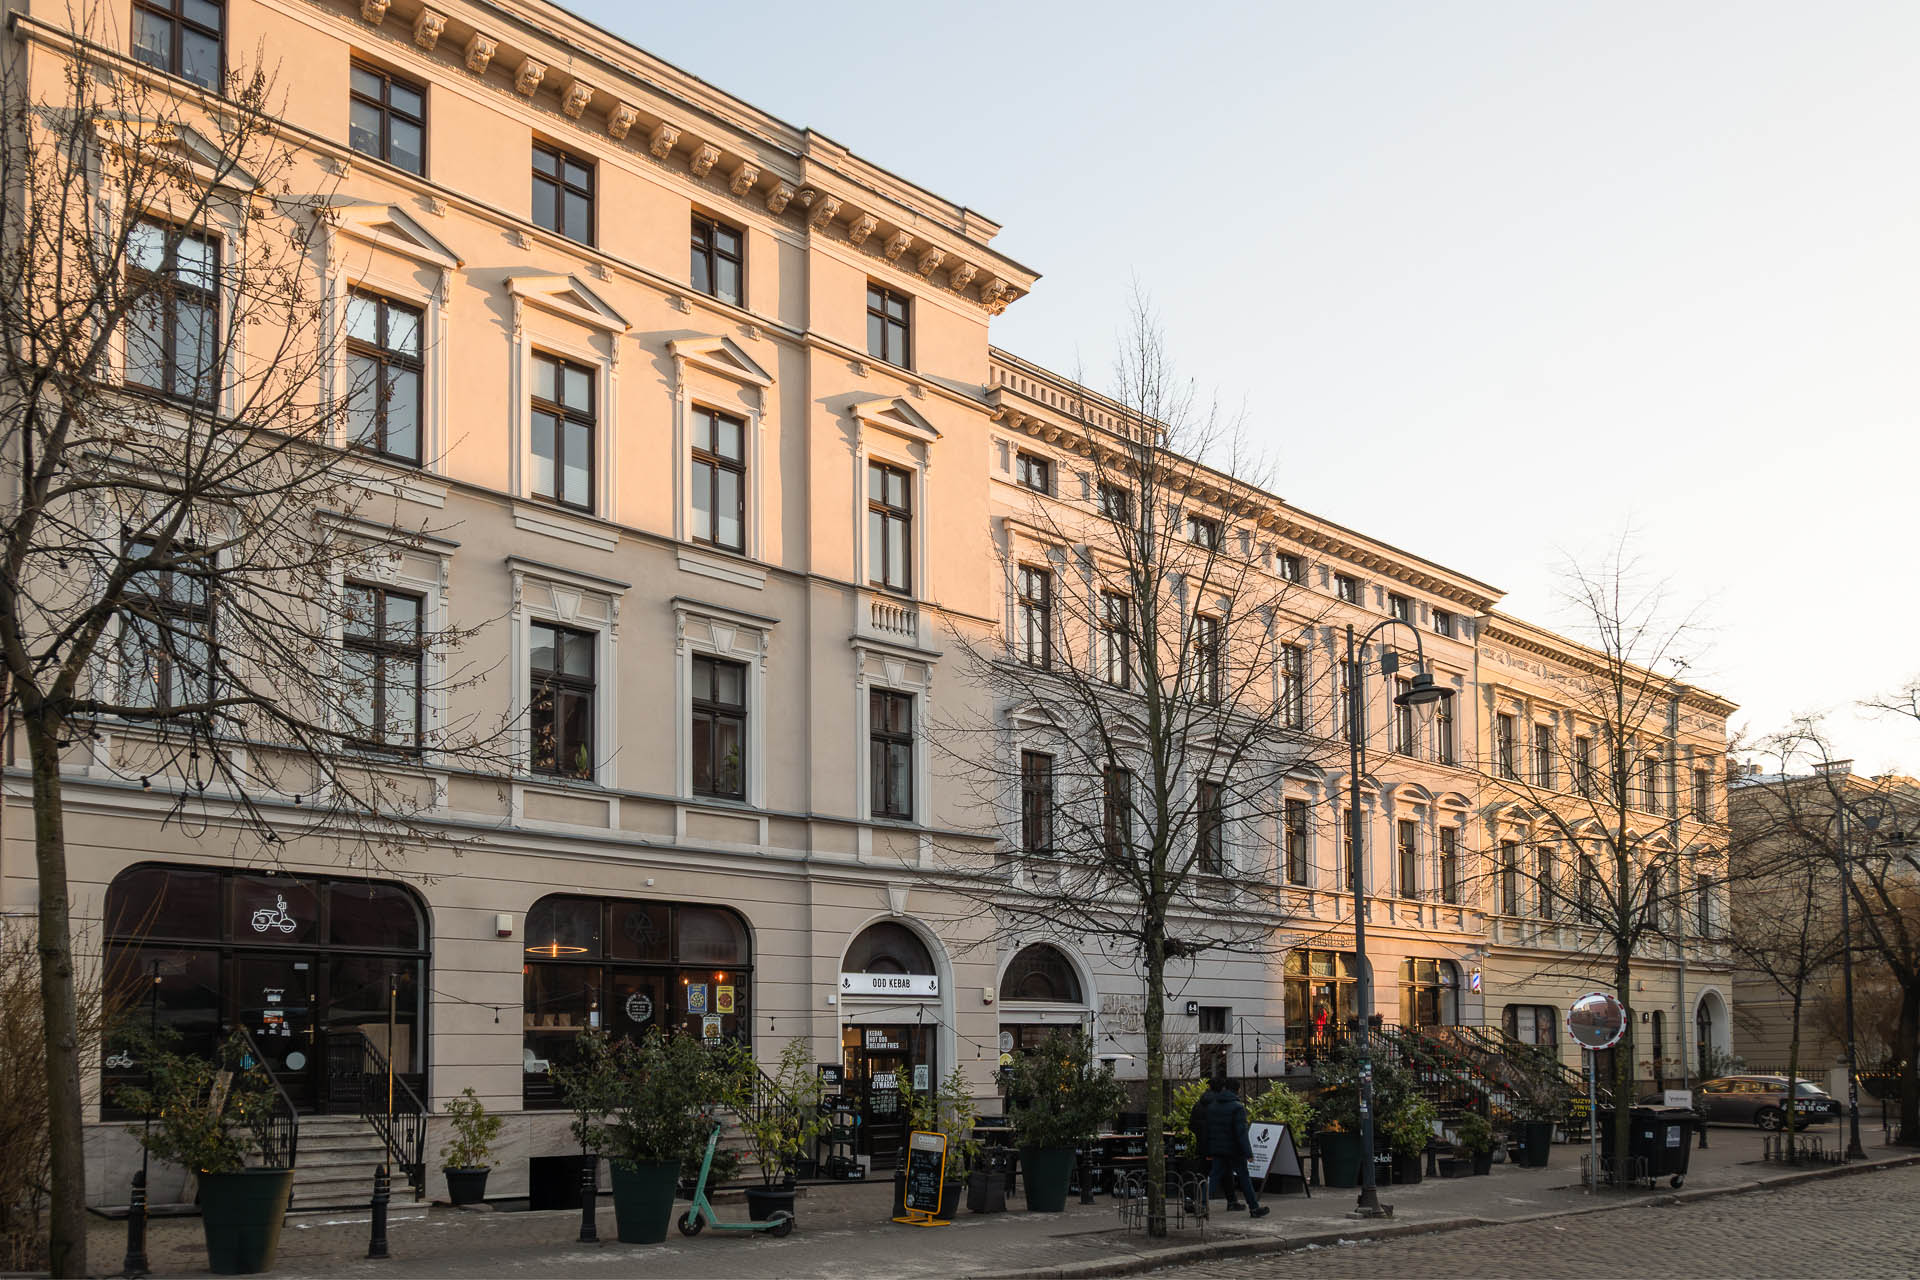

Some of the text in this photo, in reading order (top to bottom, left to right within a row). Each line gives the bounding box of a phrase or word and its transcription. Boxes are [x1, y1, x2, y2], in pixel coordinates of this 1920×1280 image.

[872, 978, 911, 988] ODD KEBAB
[871, 1081, 899, 1089] OTWARCIA
